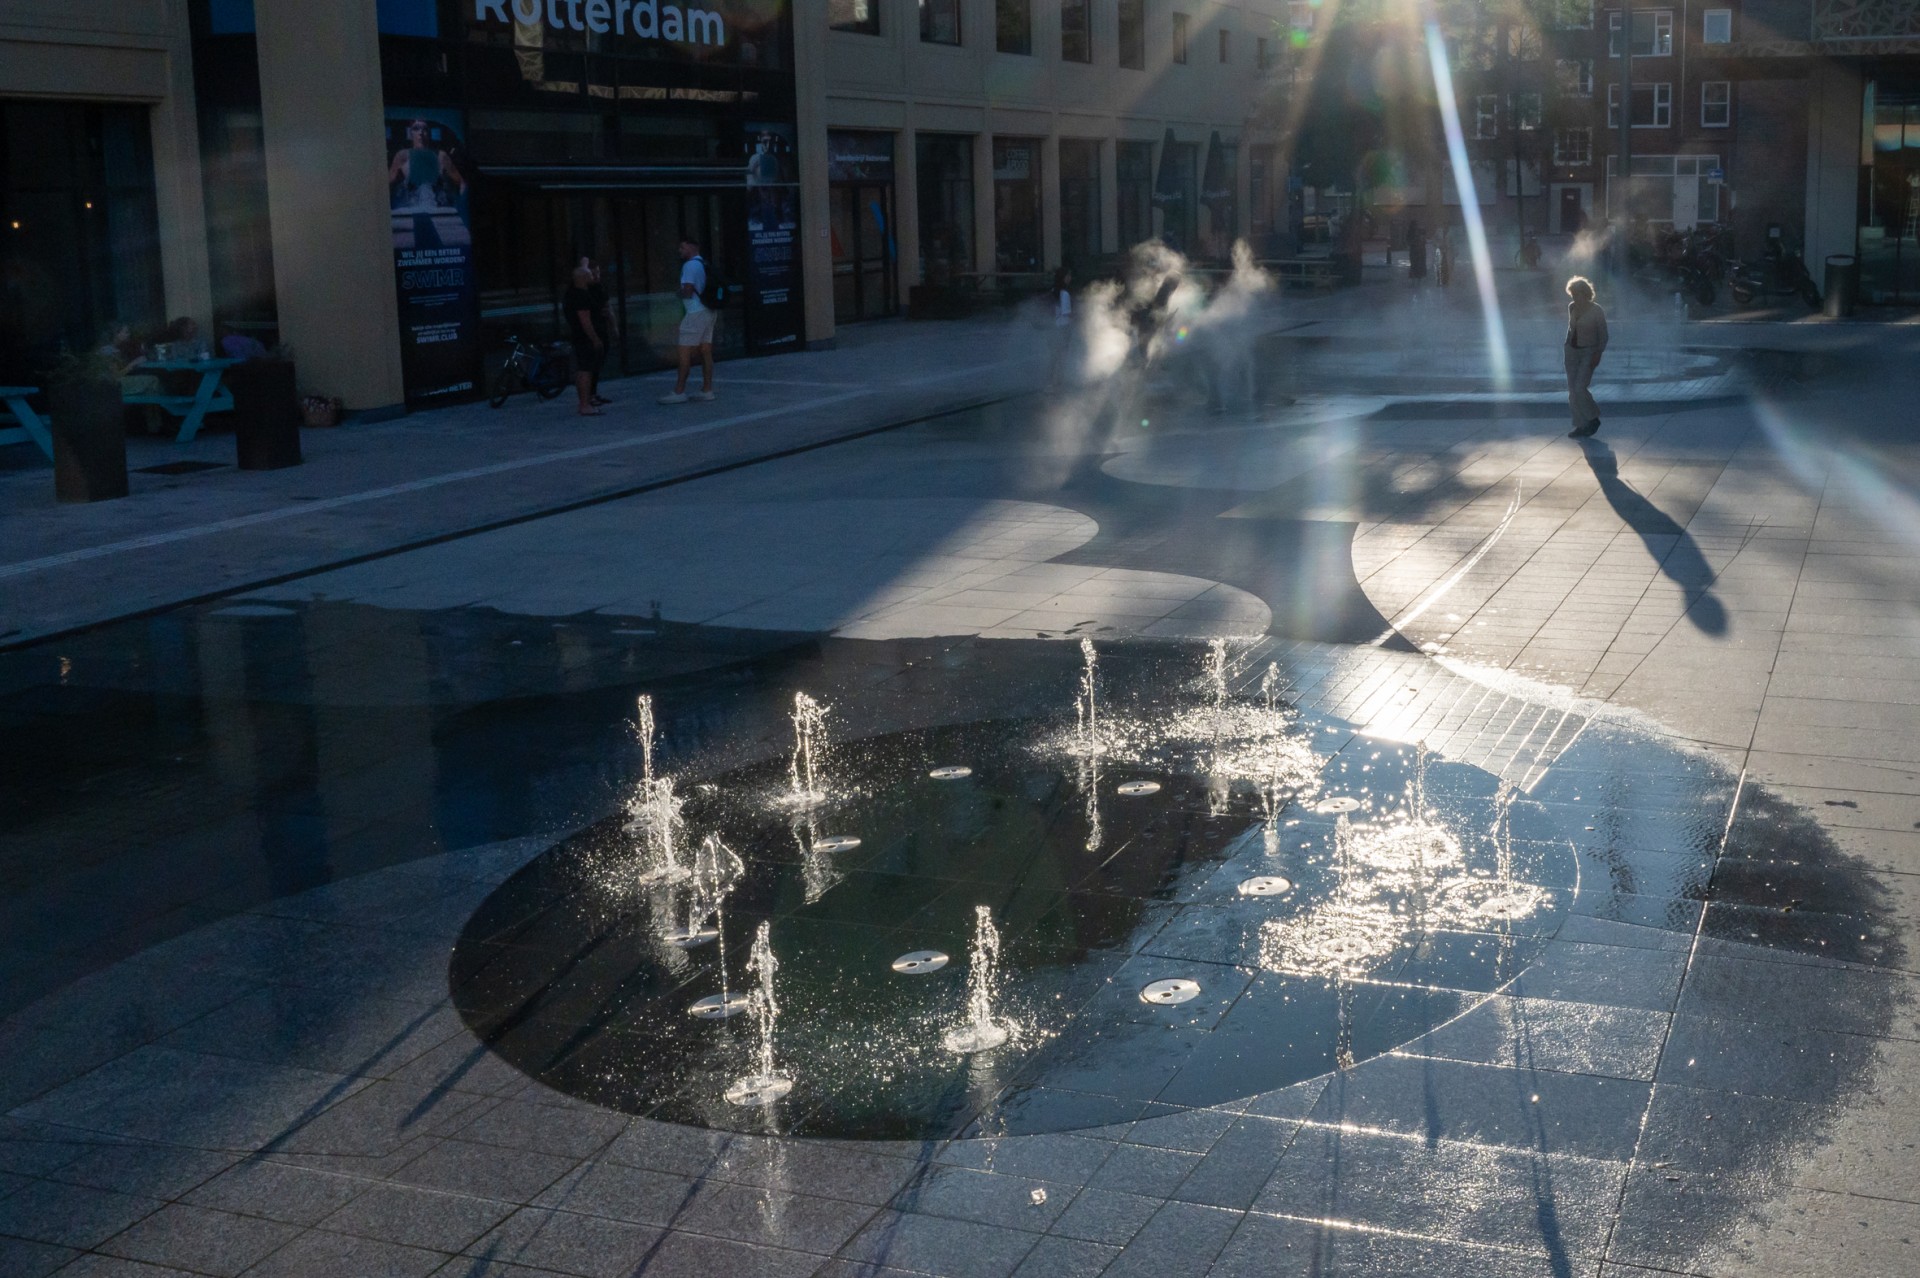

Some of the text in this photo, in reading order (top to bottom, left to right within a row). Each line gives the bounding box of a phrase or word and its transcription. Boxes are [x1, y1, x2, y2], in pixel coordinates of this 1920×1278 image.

[402, 250, 415, 258] WIL
[398, 255, 466, 267] ZWEMMER WORDEN?
[401, 268, 465, 289] SWIMR
[416, 333, 457, 344] SWIMR.CLUB
